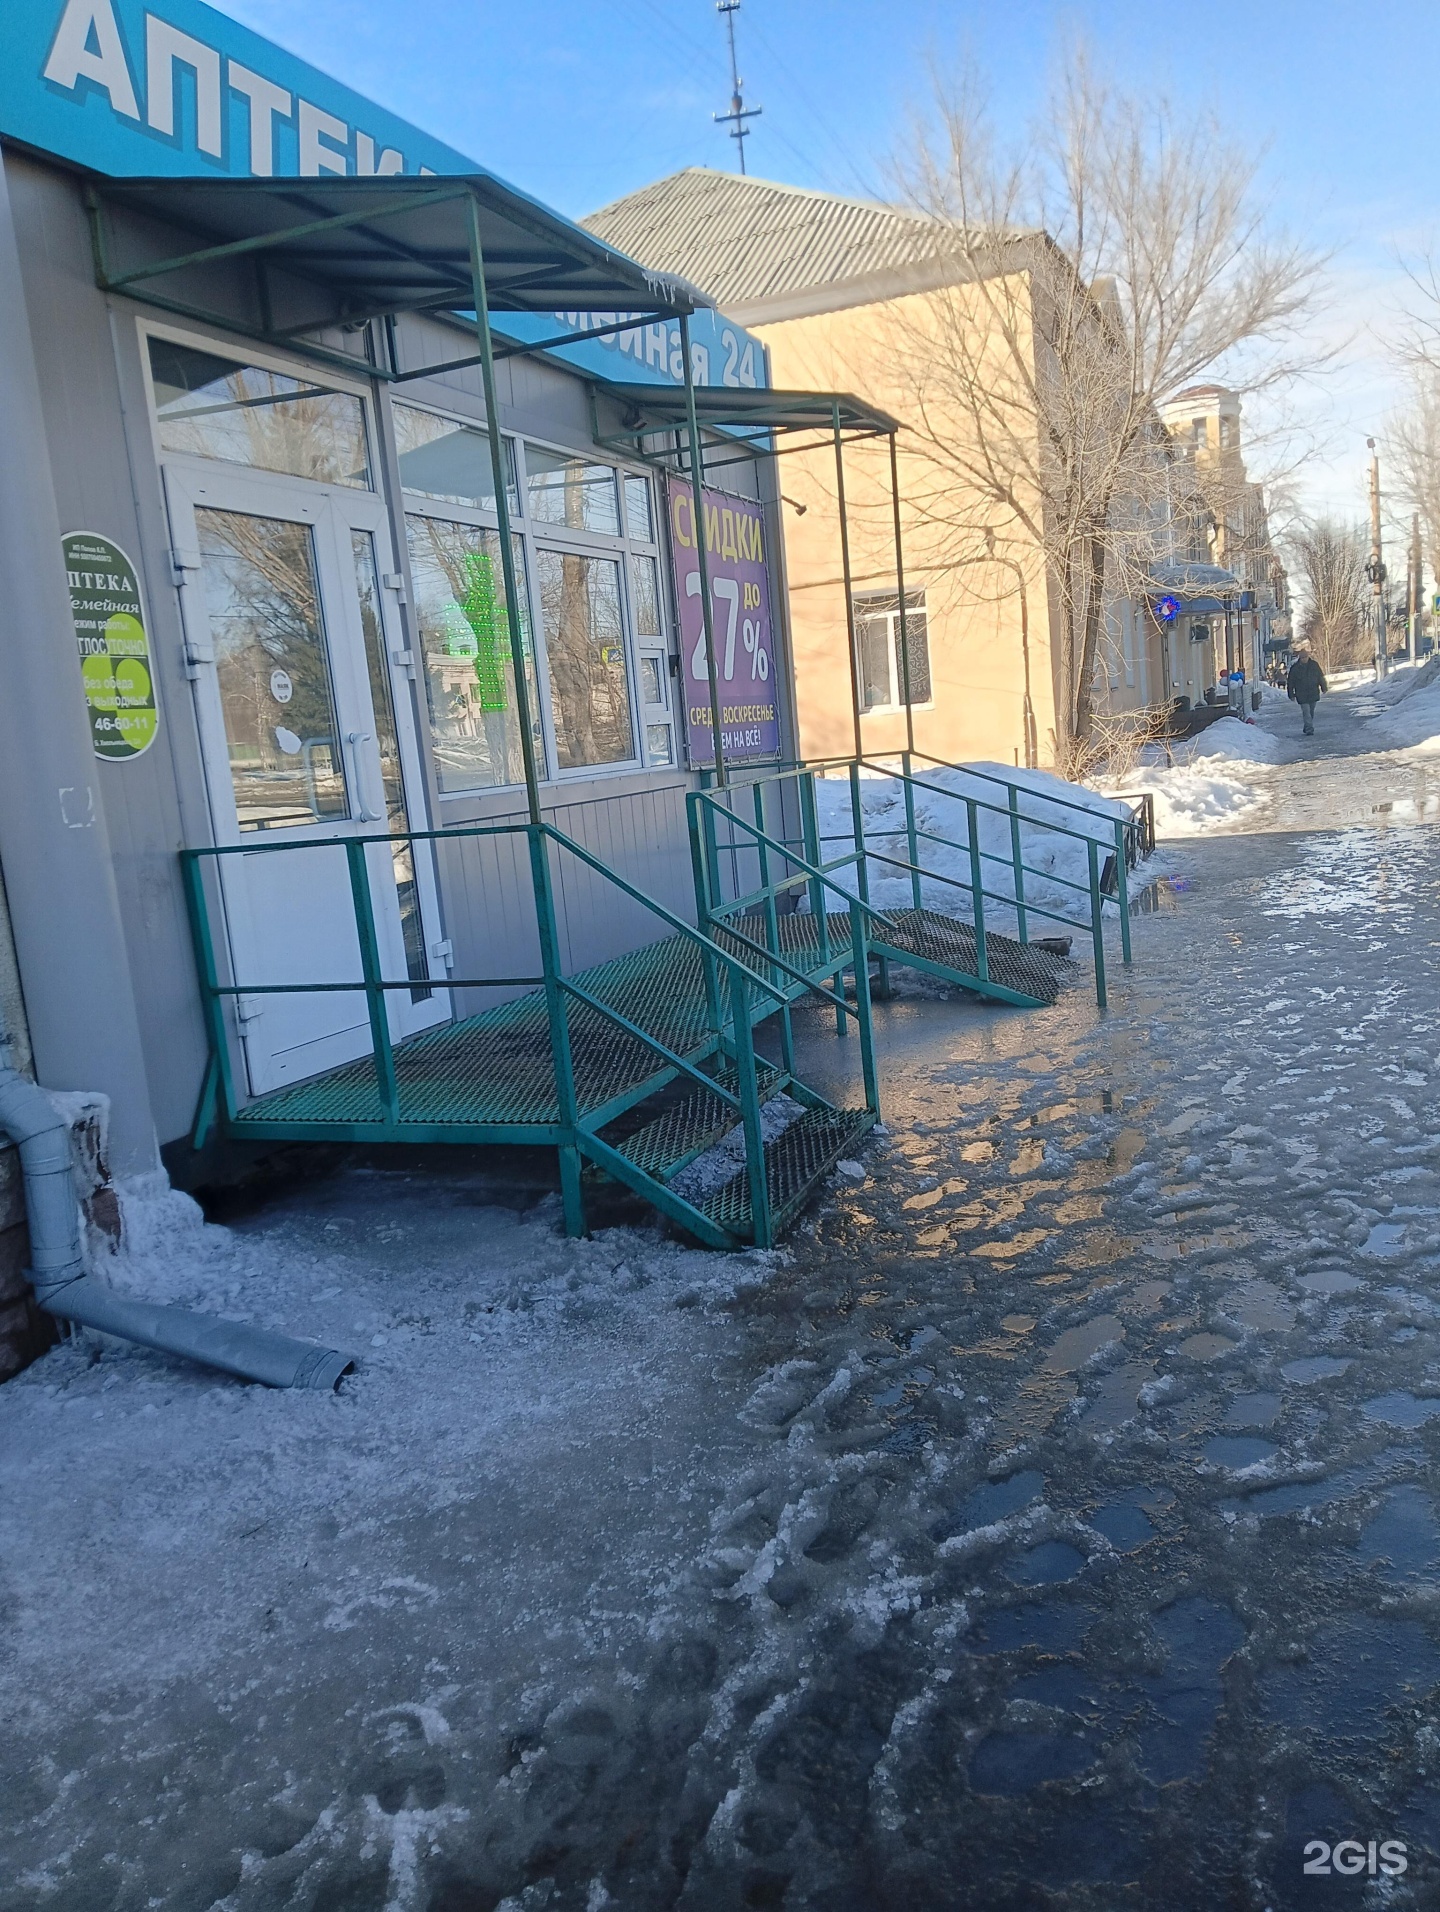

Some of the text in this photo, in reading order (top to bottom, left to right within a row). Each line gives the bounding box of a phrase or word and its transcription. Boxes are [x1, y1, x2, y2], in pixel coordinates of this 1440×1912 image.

[43, 0, 438, 177] АПТЕ
[555, 312, 757, 387] ейная 24
[66, 570, 133, 592] ПТЕКА
[70, 594, 140, 613] емейная
[74, 619, 97, 630] ежим
[77, 637, 145, 656] ГЛОСУТОЧНО
[94, 716, 149, 731] 46-60-11
[690, 704, 774, 728] СРЕД, ВОСКРЕСЕНЬЕ
[711, 725, 761, 751] ЕМ НА ВСЁ!
